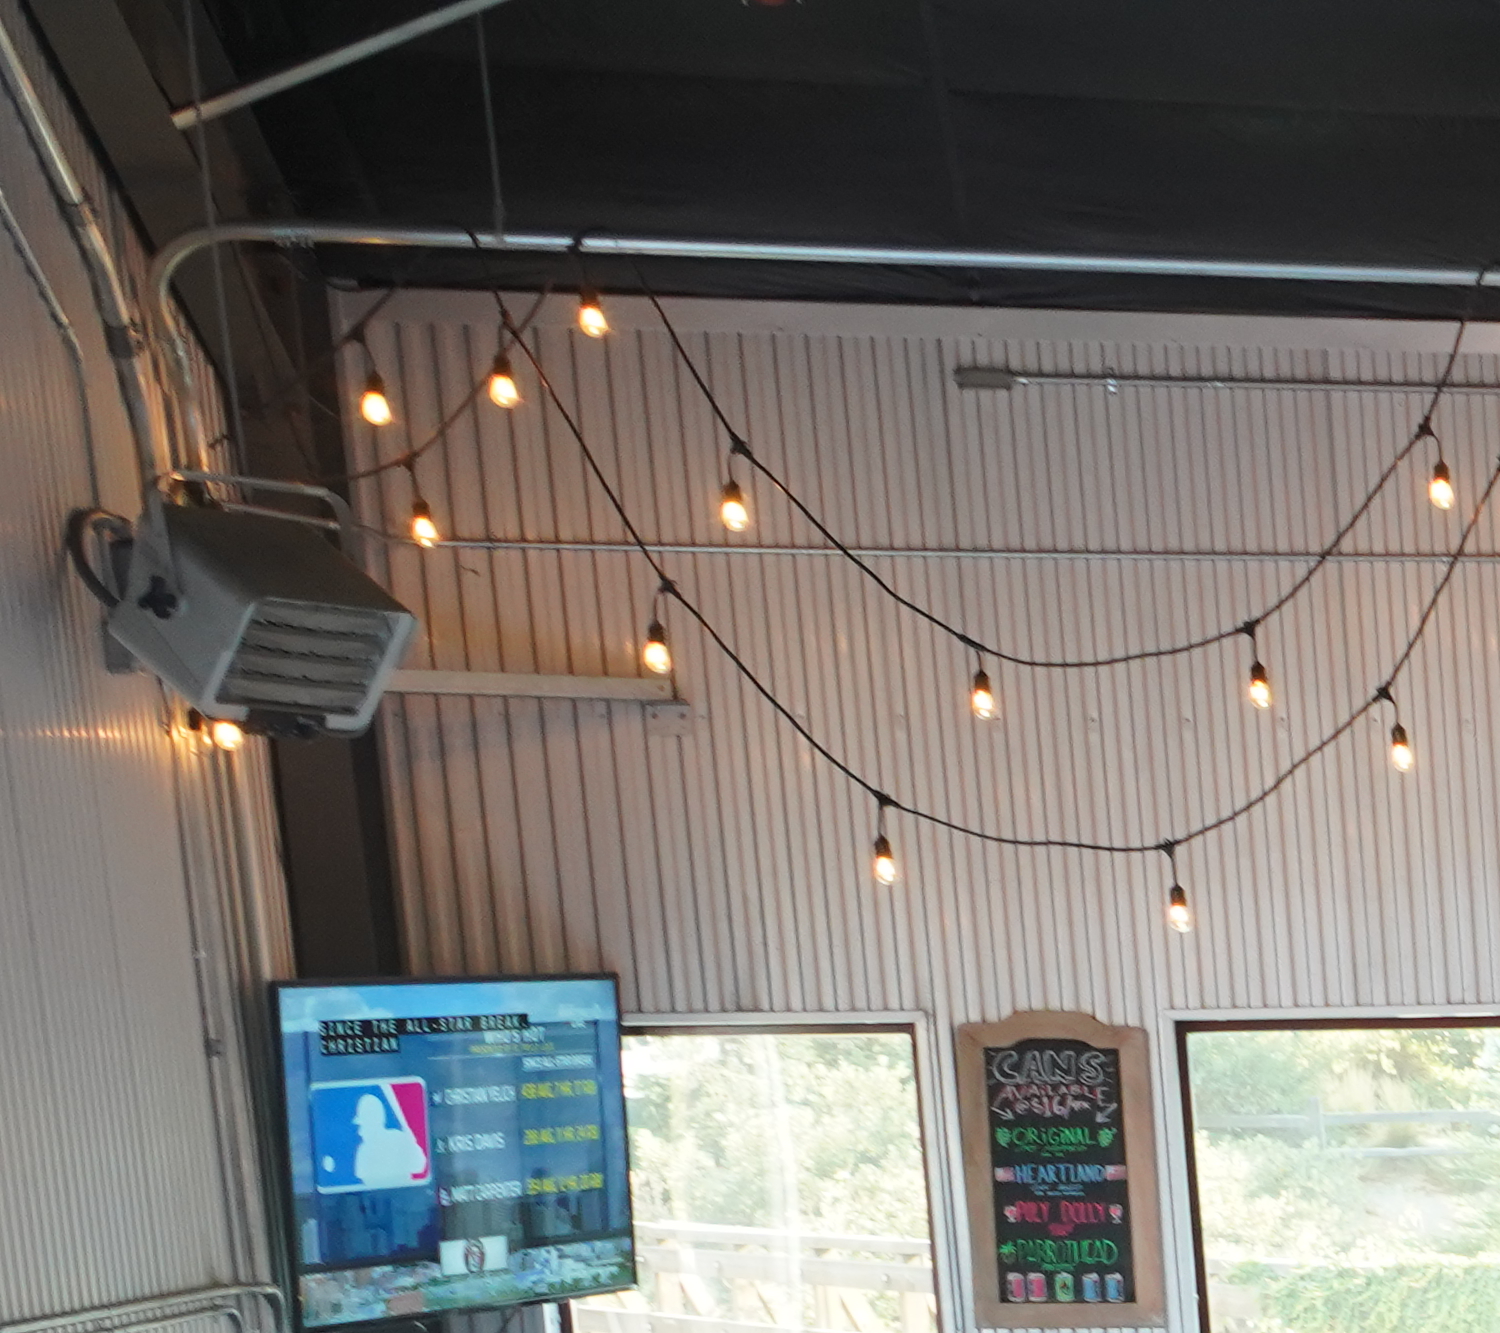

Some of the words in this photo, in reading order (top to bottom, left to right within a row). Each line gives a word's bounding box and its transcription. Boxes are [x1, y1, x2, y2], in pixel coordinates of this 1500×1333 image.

[318, 1020, 363, 1037] SINCE
[371, 1019, 398, 1035] THE
[992, 1049, 1107, 1086] CANS
